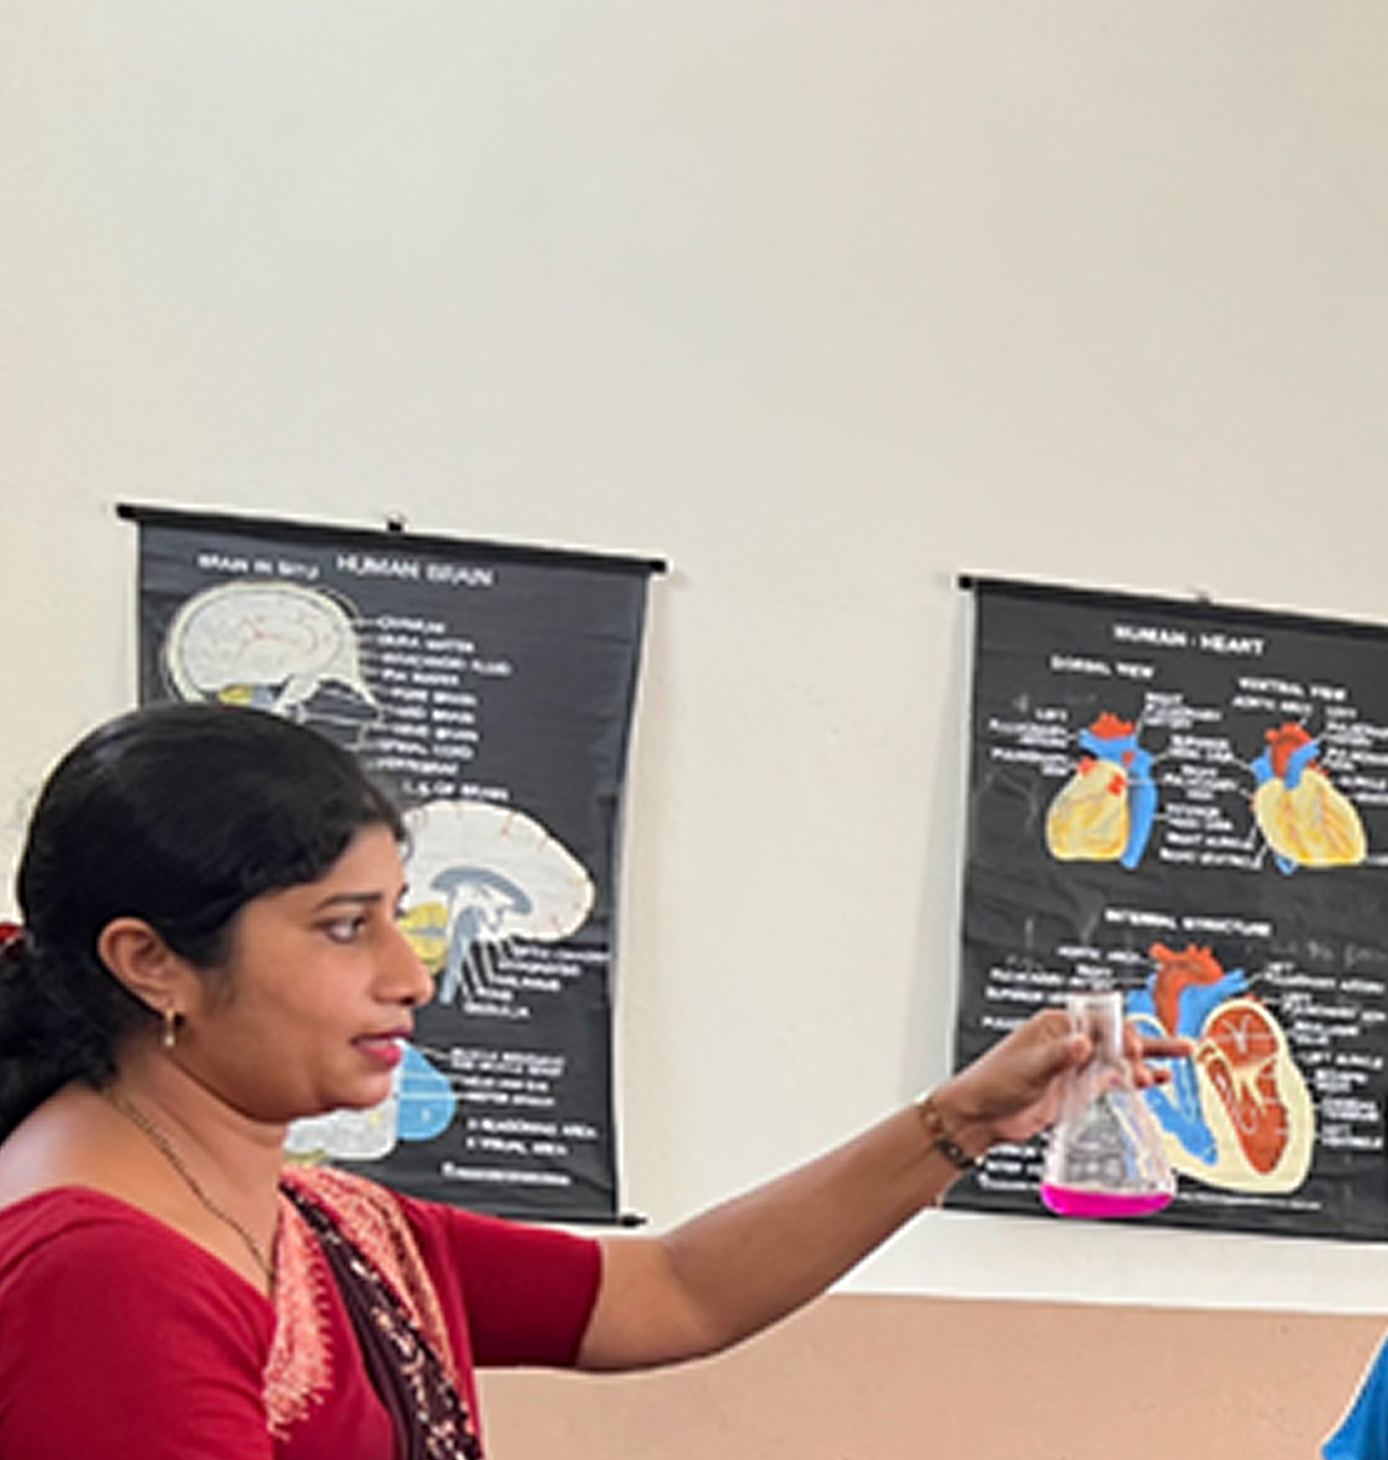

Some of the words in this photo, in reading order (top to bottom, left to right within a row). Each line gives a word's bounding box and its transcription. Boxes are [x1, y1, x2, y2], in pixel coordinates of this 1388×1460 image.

[254, 558, 272, 574] IN
[335, 554, 419, 580] HUMAN
[426, 562, 494, 587] BRAIN
[1113, 624, 1187, 647] HUMAN
[1201, 633, 1265, 656] HEART
